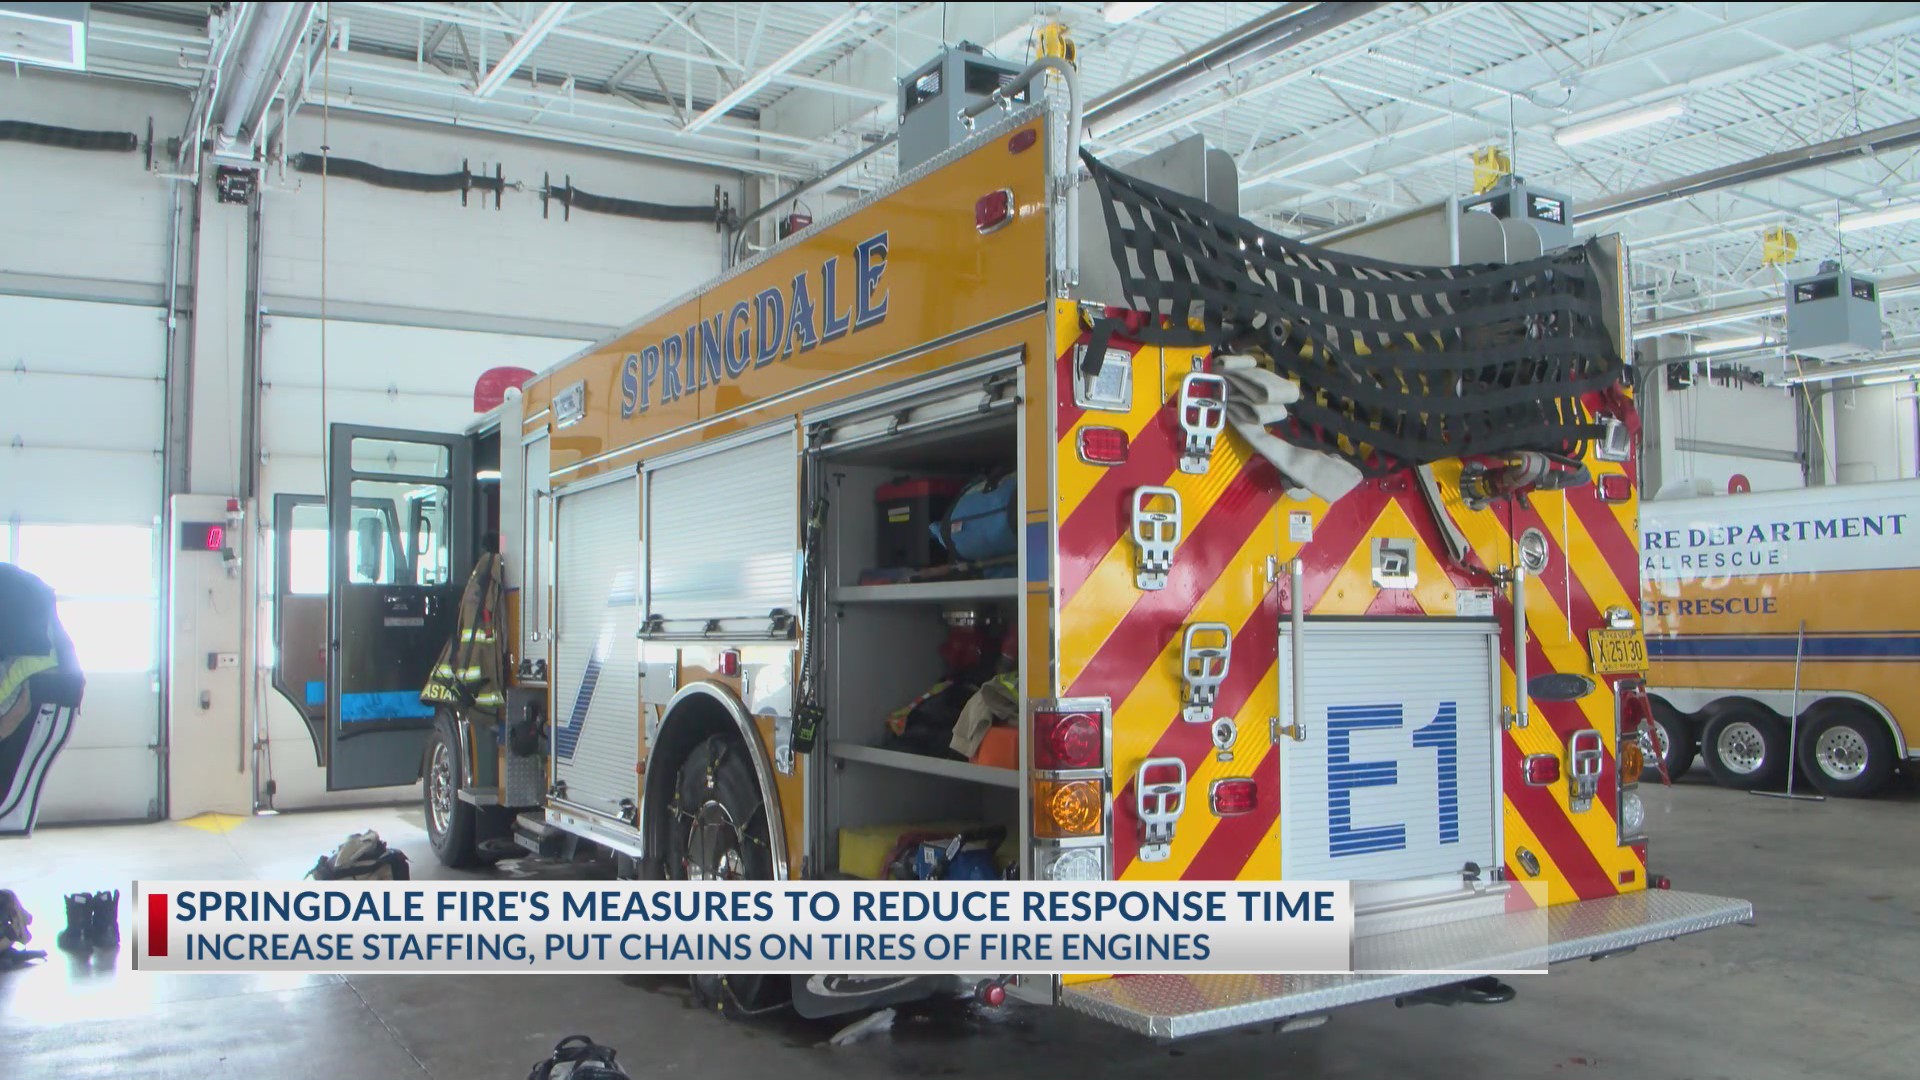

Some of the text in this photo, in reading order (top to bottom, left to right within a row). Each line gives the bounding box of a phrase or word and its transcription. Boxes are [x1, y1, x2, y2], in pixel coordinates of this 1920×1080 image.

[622, 230, 889, 419] SPRINGDALE
[1645, 514, 1906, 550] RE DEPARTMENT
[1646, 550, 1779, 570] AL RESCUE
[1644, 597, 1777, 616] SE RESCUE
[422, 684, 457, 701] ASTA
[1327, 701, 1459, 858] E1
